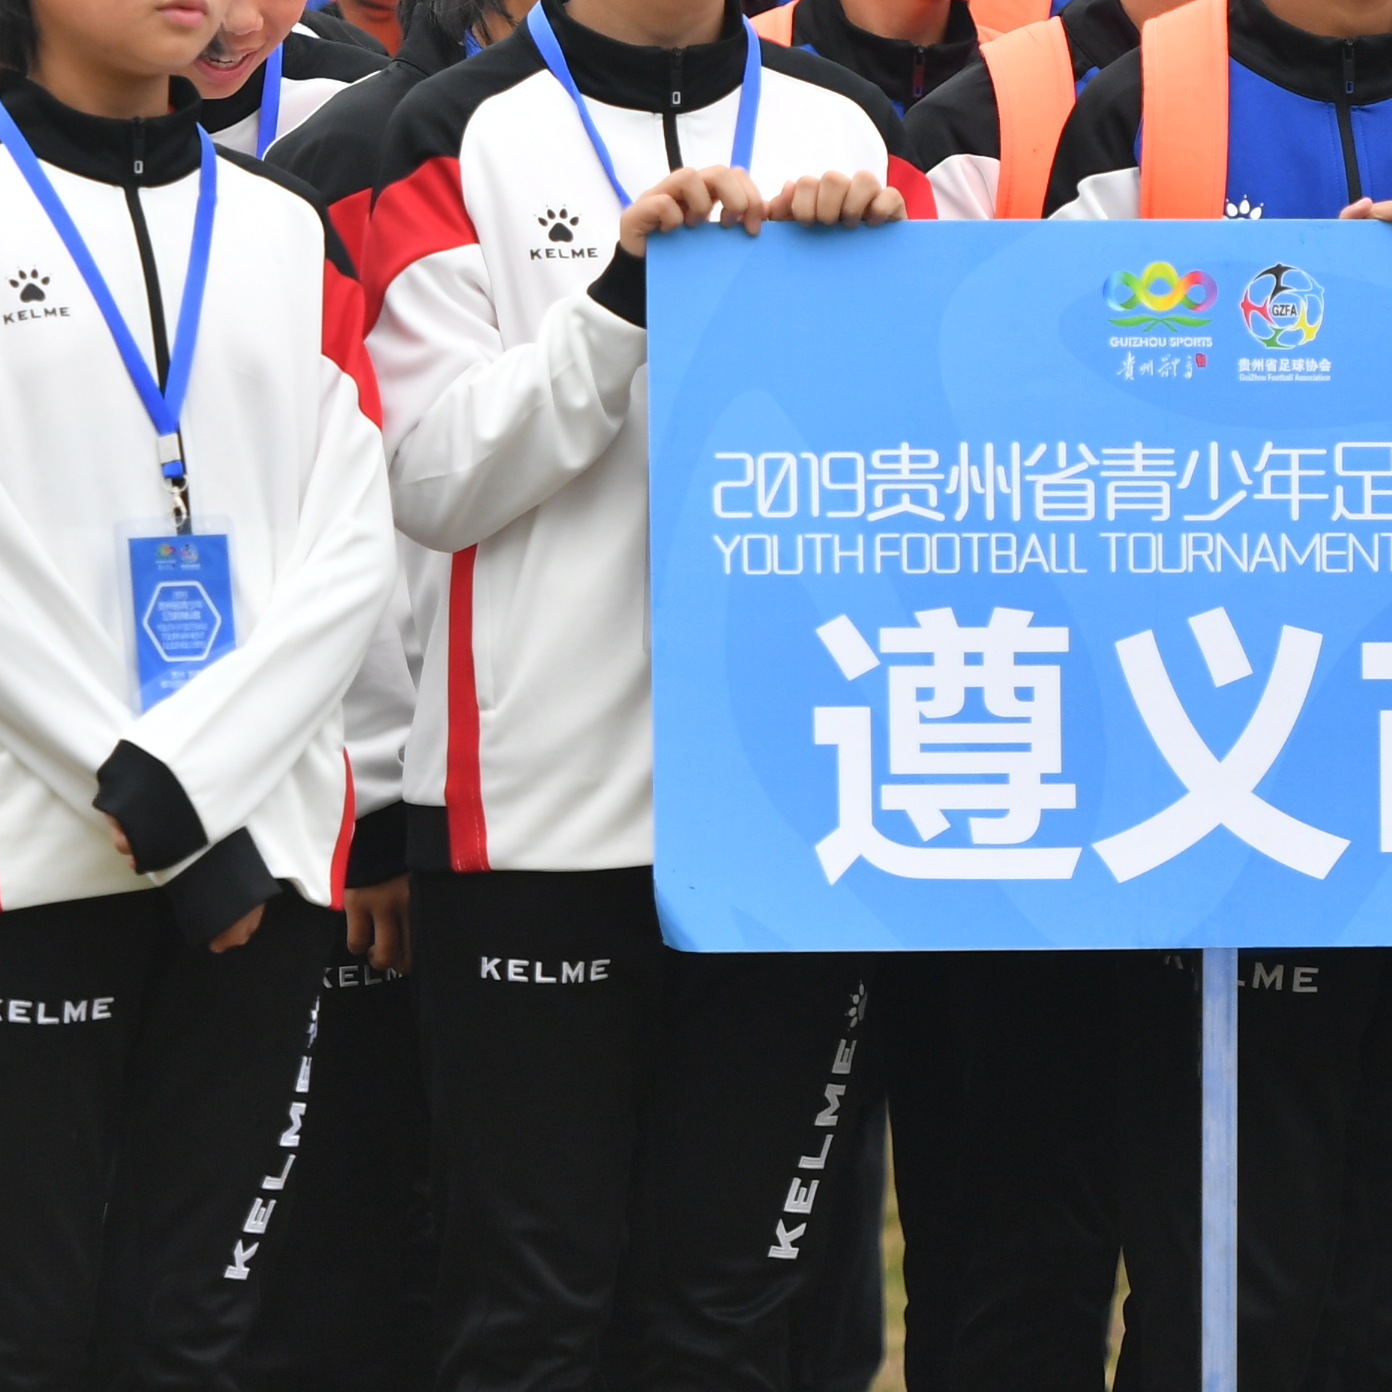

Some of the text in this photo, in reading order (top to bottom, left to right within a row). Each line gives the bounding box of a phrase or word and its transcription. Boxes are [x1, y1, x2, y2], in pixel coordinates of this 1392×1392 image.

[529, 247, 599, 260] KELME
[3, 307, 70, 325] KELME
[1272, 304, 1298, 317] GZFA
[1110, 336, 1213, 348] GUIZHOU SPORTS
[1238, 358, 1332, 372] 贵州省足球协会
[1268, 373, 1293, 381] Football
[1295, 373, 1331, 381] Association
[713, 533, 864, 575] YOUTH
[875, 533, 1088, 574] FOOTBALL
[480, 955, 611, 984] KELME
[768, 1038, 857, 1259] KELME
[224, 1055, 312, 1280] KELME
